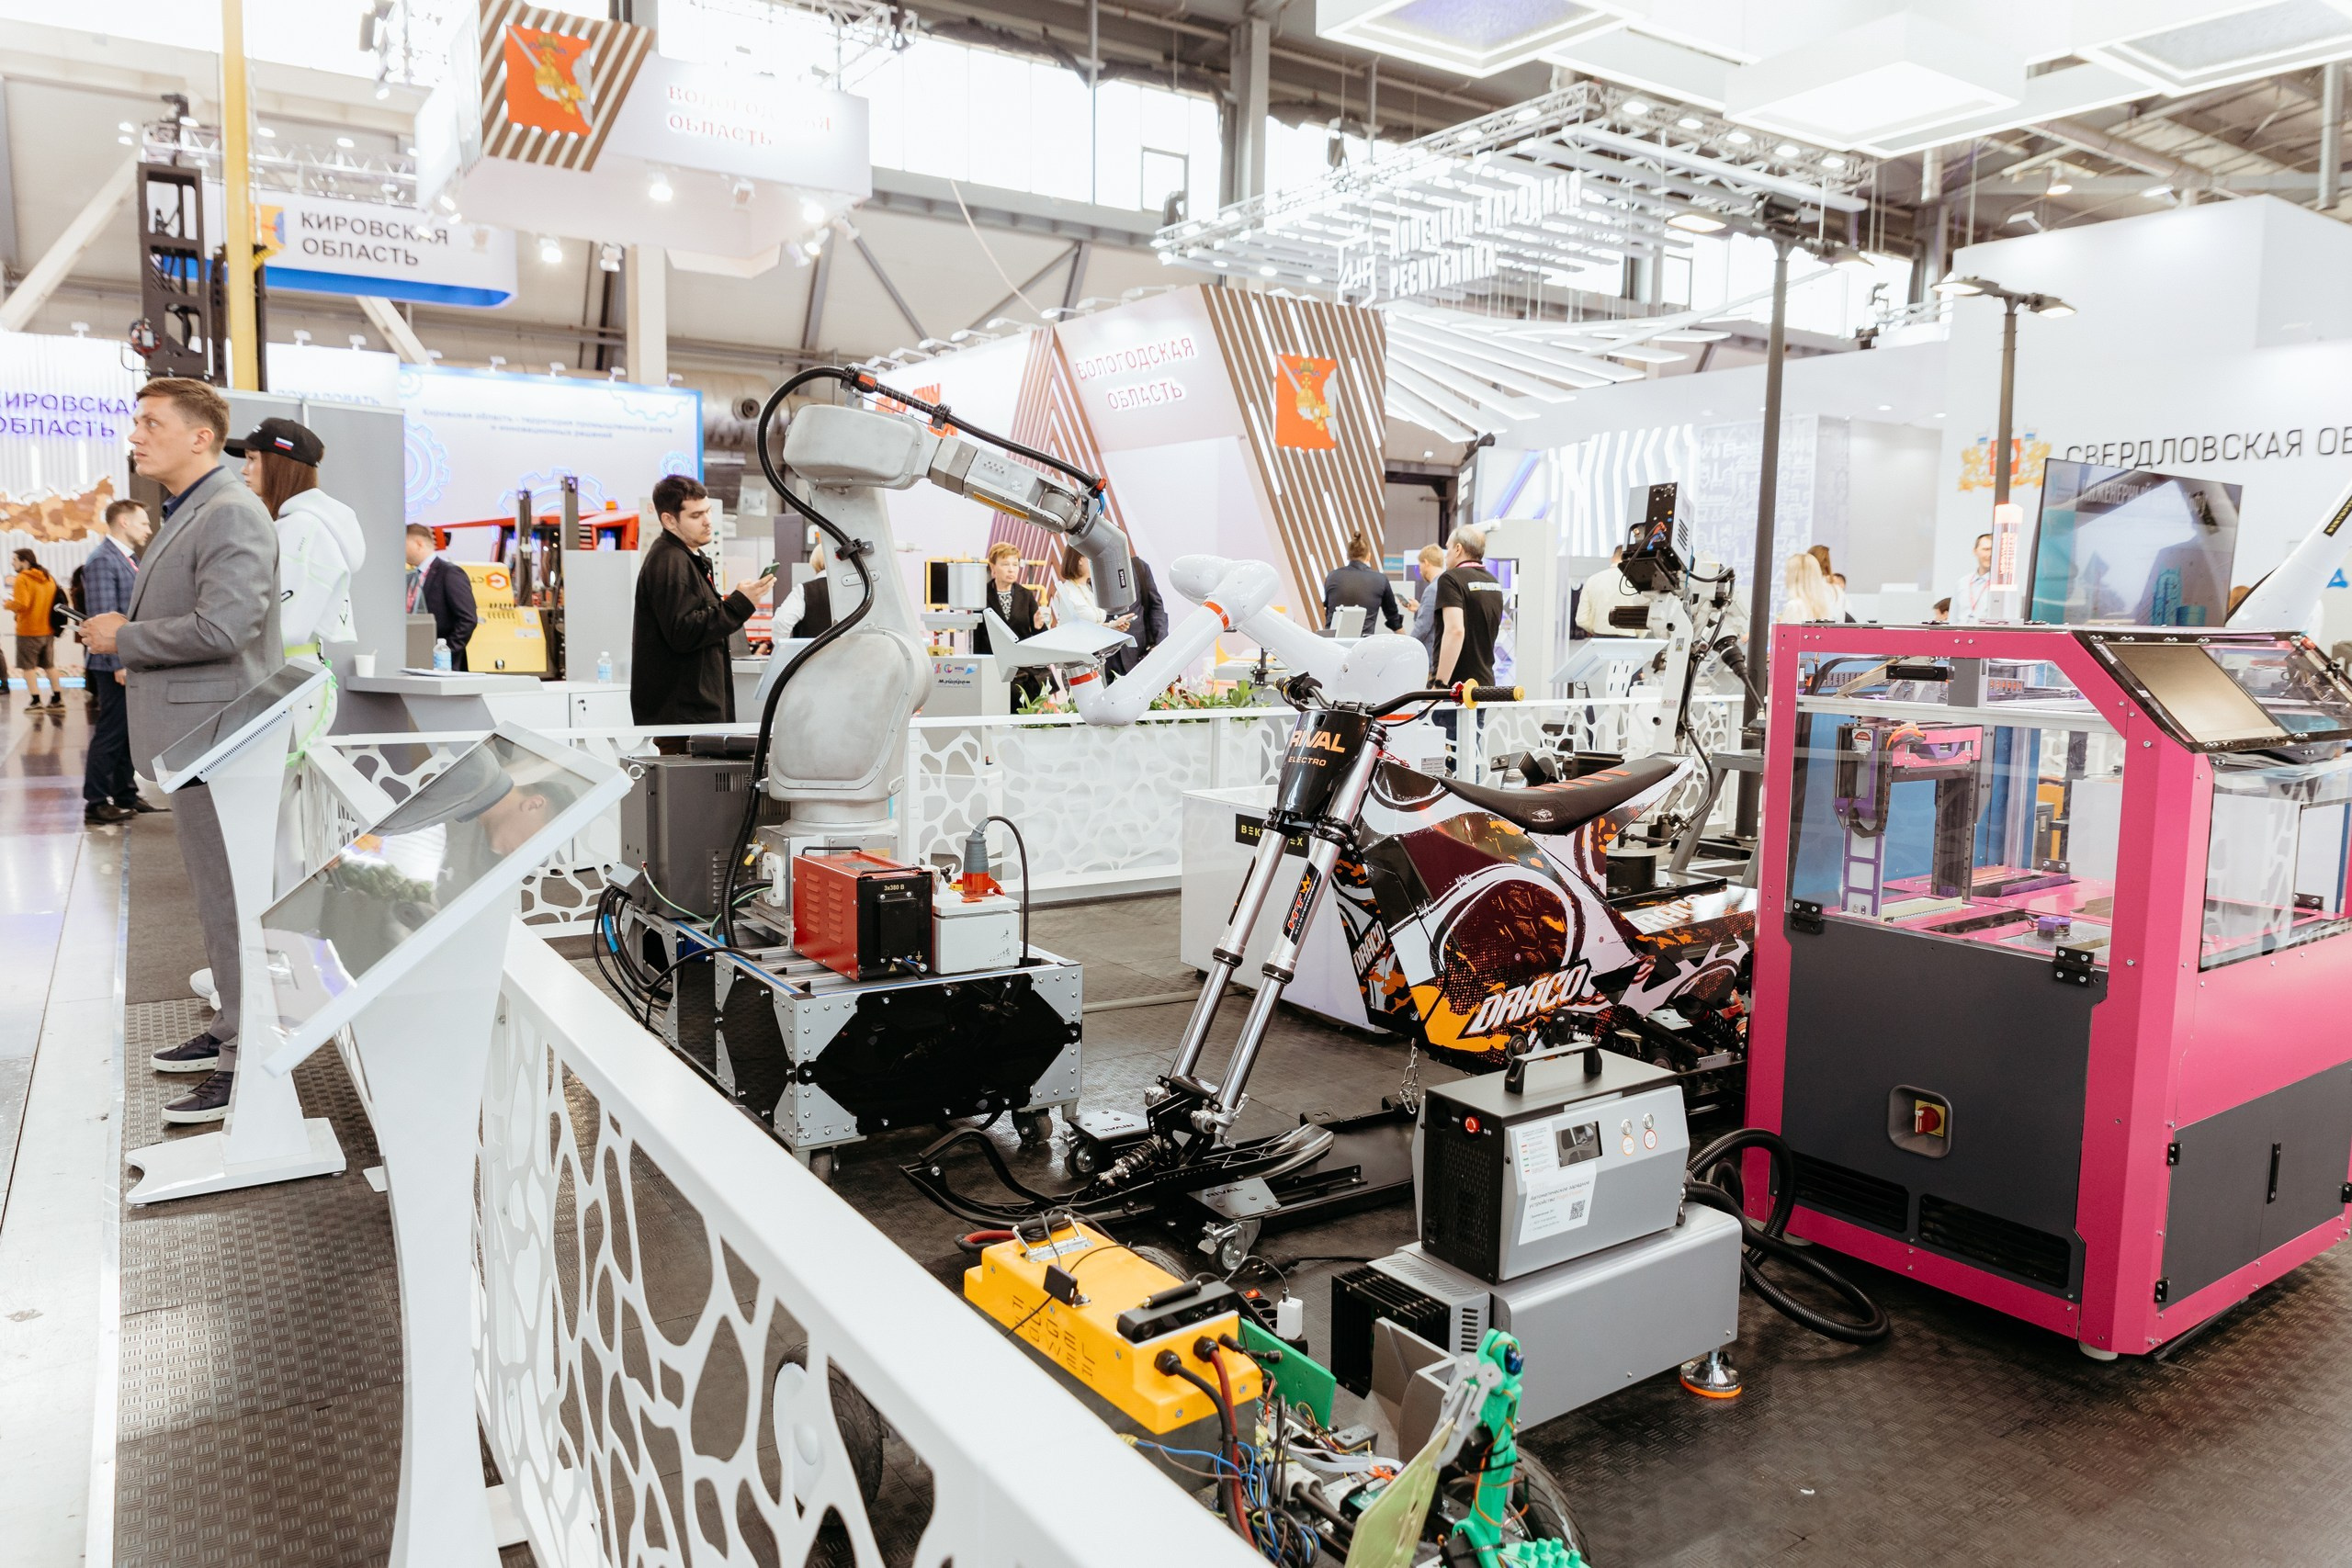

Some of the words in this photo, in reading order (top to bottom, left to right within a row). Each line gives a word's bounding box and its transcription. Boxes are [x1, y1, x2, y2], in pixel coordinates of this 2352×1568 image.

[302, 237, 419, 266] ОБЛАСТЬ
[1388, 241, 1498, 299] РЕСПУБЛИКА
[1075, 337, 1194, 380] ВОЛОГОДСКАЯ
[0, 391, 137, 414] ИРОВСКА
[1107, 381, 1182, 410] ОБЛАСТЬ
[2066, 428, 2302, 469] СВЕРДЛОВСКАЯ
[1289, 729, 1346, 753] RIVAL
[1288, 756, 1327, 766] ELECTRO
[1352, 919, 1386, 975] DRACO
[1464, 963, 1589, 1036] DRACO
[1205, 1186, 1244, 1198] RIVAL
